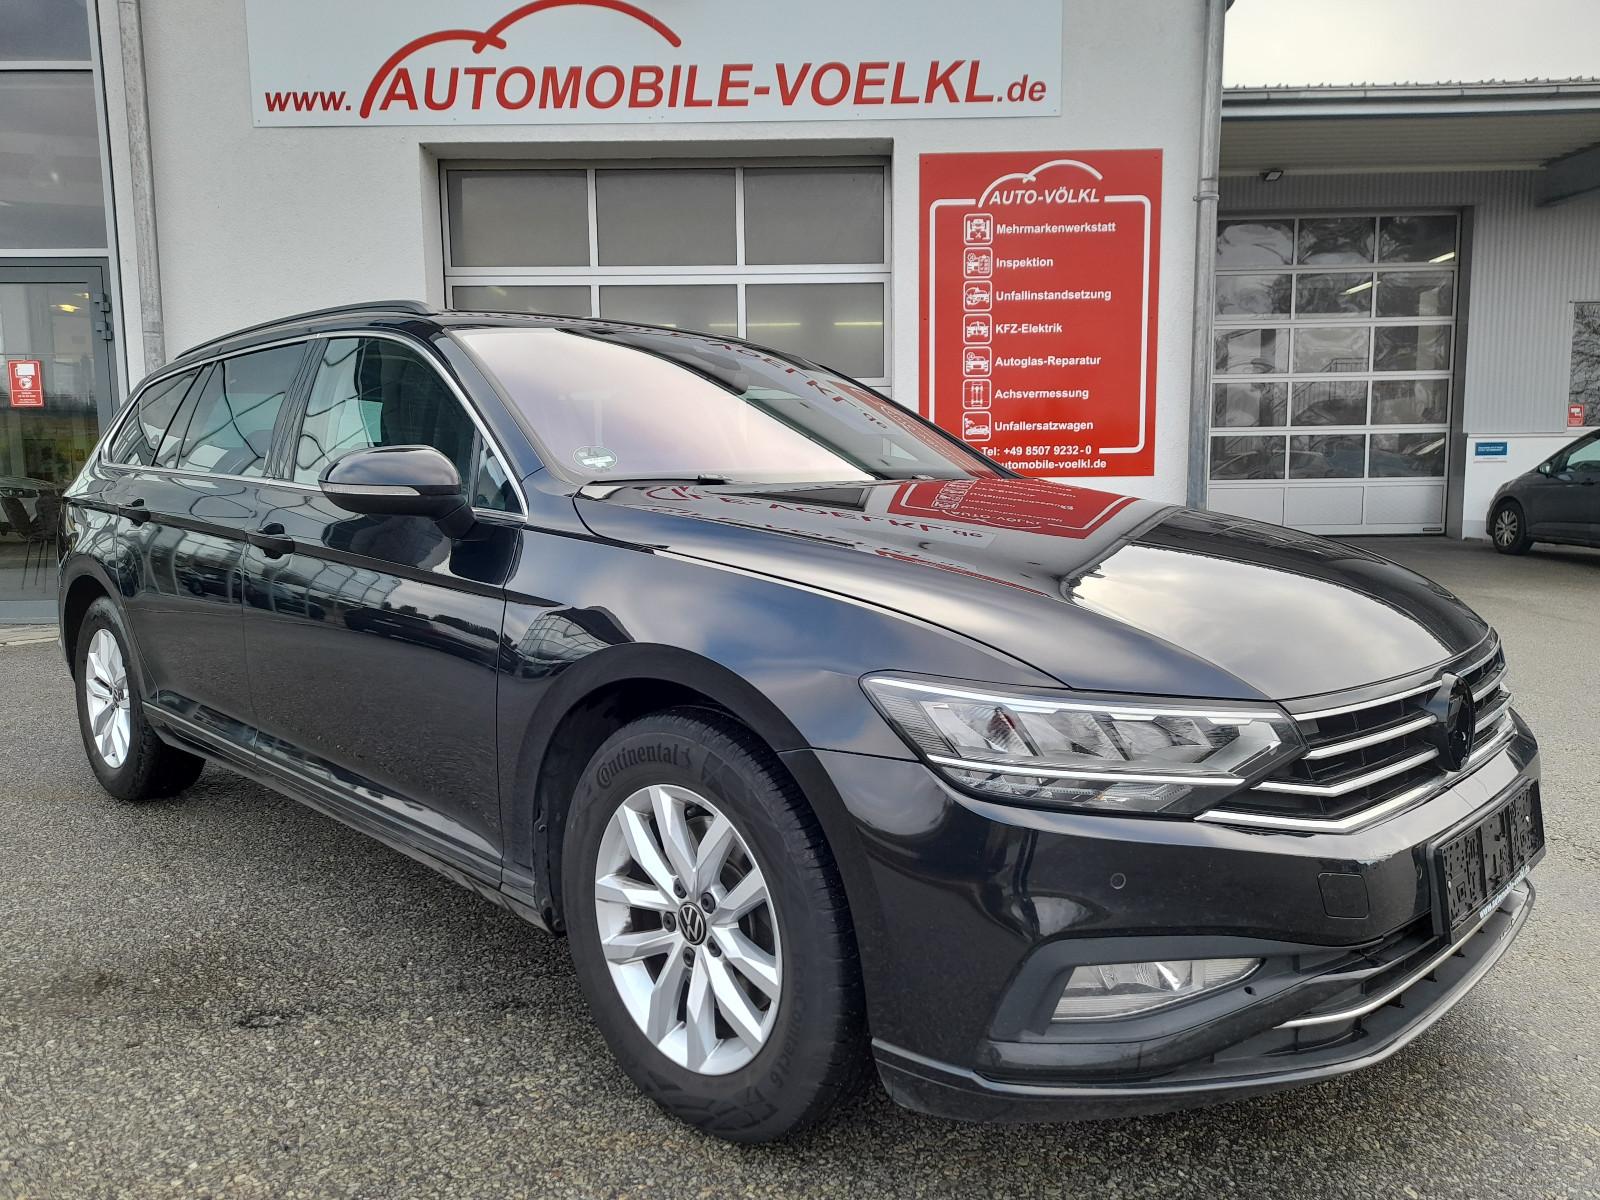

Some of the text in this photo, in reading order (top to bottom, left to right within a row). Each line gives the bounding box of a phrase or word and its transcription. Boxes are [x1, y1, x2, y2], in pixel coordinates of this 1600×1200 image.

[988, 187, 1101, 206] AUTO-VÖLKL
[996, 222, 1117, 235] Mehrmarkenwerkstatt
[996, 257, 1054, 270] Inspektion
[995, 289, 1112, 302] Unfallinstandsetzung
[995, 323, 1063, 335] KFZ-Elektrik
[994, 355, 1102, 369] Autoglas-Reparatur
[994, 388, 1090, 400] Achsvermessung
[994, 421, 1094, 434] Unfallersatzwagen
[981, 446, 1000, 456] Tel:
[1003, 446, 1022, 456] +49
[1025, 445, 1051, 456] 8507
[1000, 459, 1107, 470] utomobile-voelkl.de
[595, 741, 680, 790] Continental
